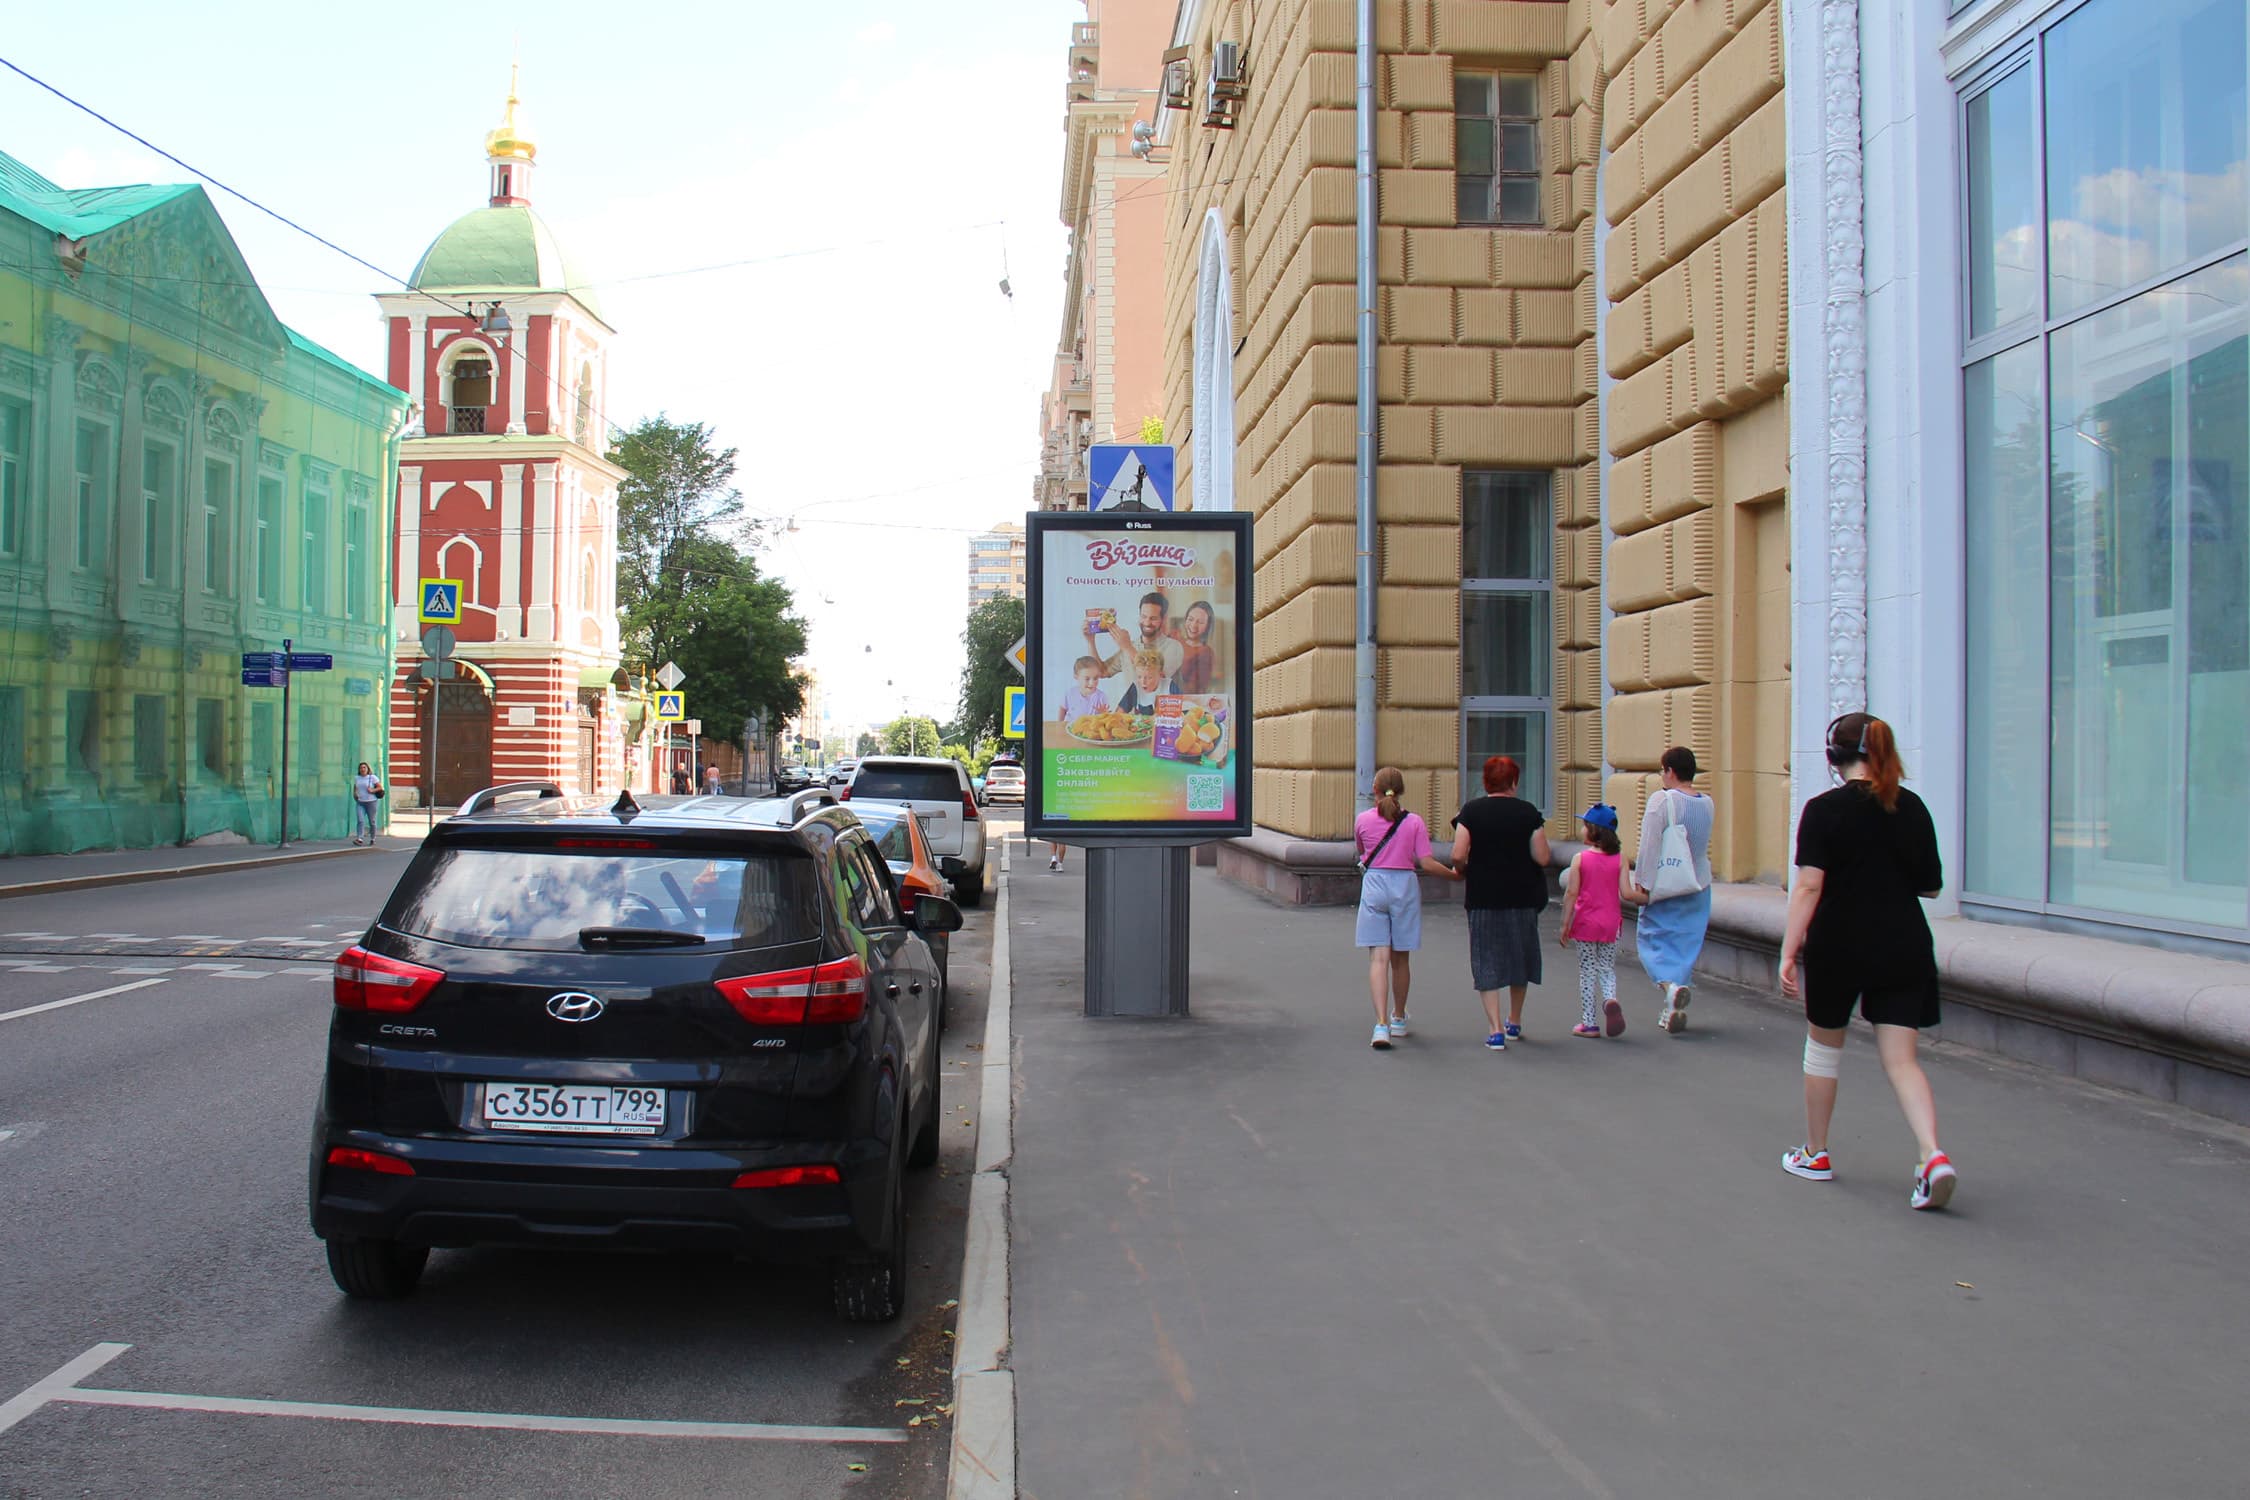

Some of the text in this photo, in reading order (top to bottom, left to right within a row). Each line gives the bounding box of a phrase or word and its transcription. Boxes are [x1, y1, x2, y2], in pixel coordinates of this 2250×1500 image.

[1066, 577, 1214, 587] Сочность, хруст и улыбки!
[1057, 767, 1131, 777] Заказывайте
[1057, 778, 1099, 788] онлайн
[379, 1024, 437, 1037] CRETA
[752, 1039, 786, 1047] 4WD
[614, 1089, 658, 1112] 799
[623, 1112, 645, 1121] RUS
